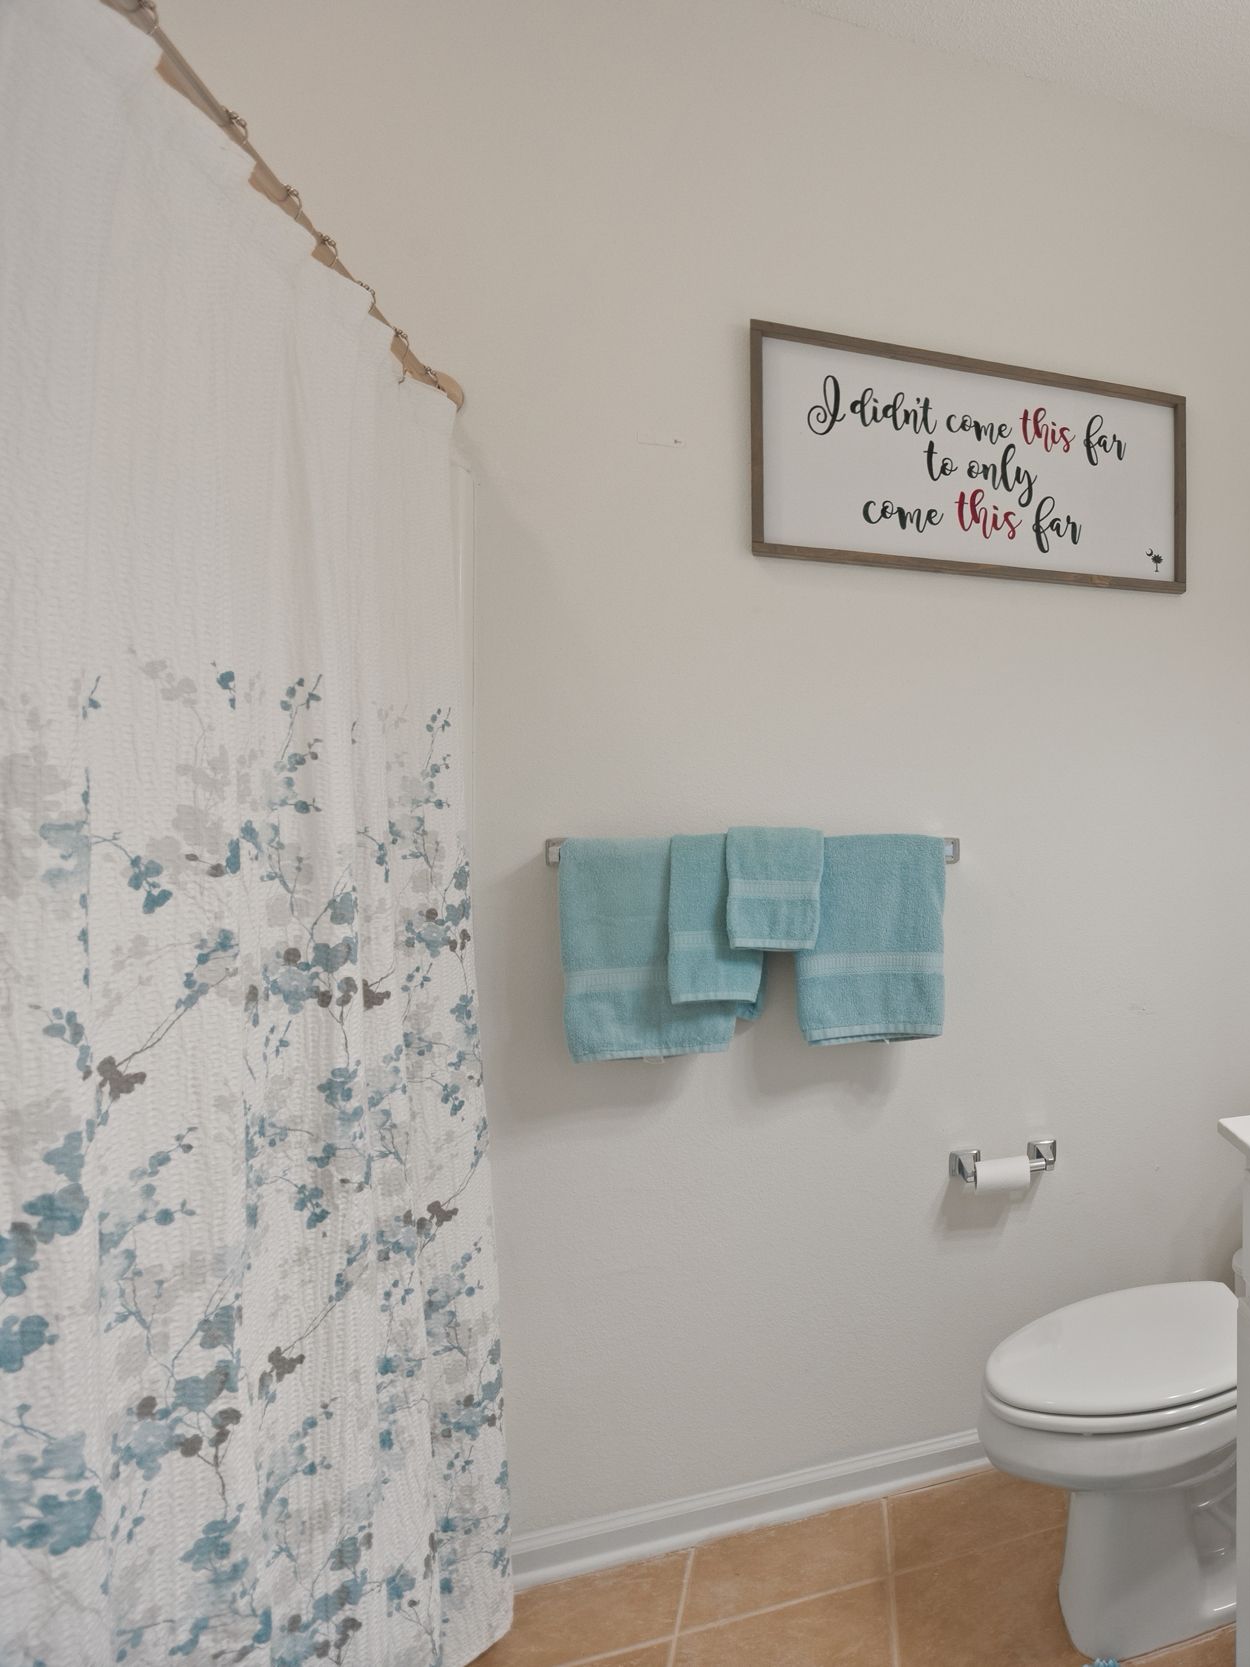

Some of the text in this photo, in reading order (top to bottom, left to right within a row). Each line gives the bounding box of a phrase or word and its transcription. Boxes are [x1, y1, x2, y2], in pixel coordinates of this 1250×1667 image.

[807, 375, 1126, 466] I didn't come this far
[923, 440, 1038, 507] to only
[862, 489, 1082, 553] come this far
